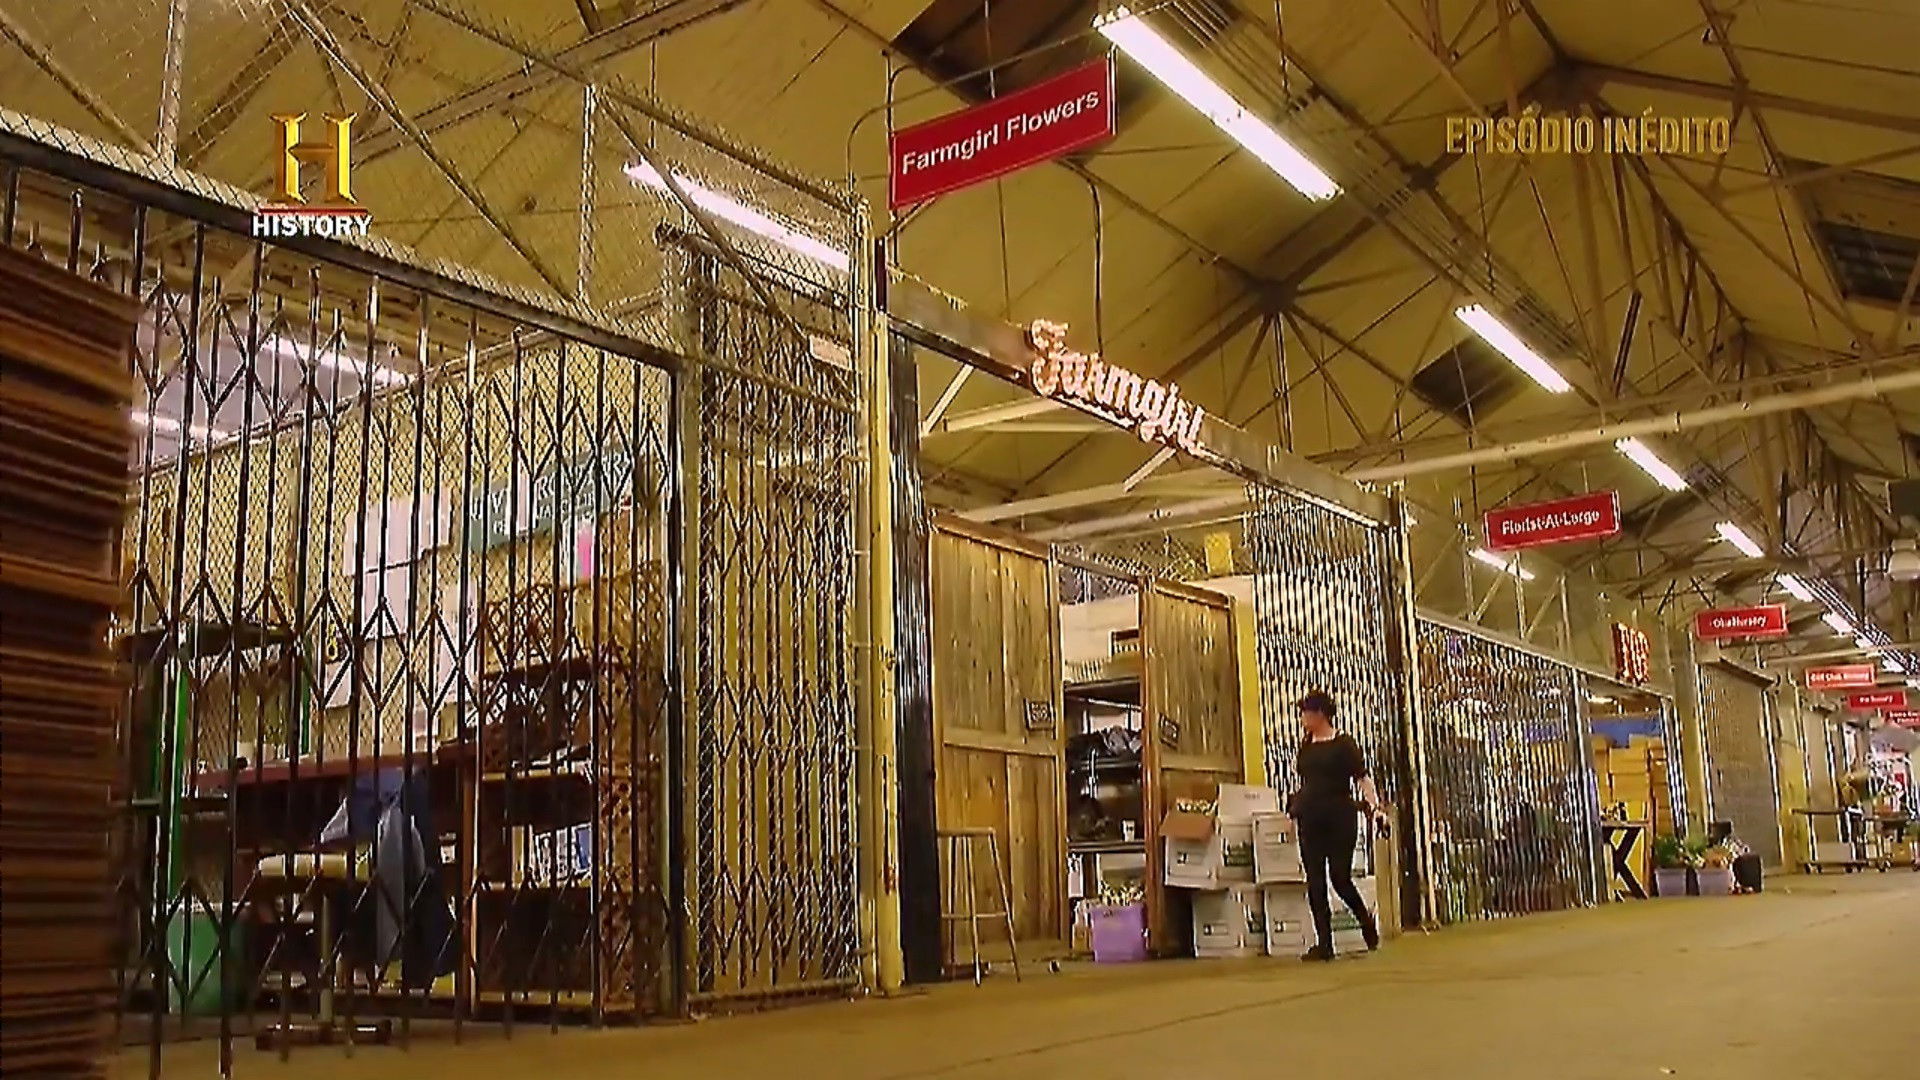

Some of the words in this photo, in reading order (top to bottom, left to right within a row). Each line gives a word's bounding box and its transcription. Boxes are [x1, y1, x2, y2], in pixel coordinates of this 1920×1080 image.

[902, 123, 998, 175] Farmgirl
[1006, 91, 1100, 140] Flowers
[1031, 318, 1206, 456] Farmgirl
